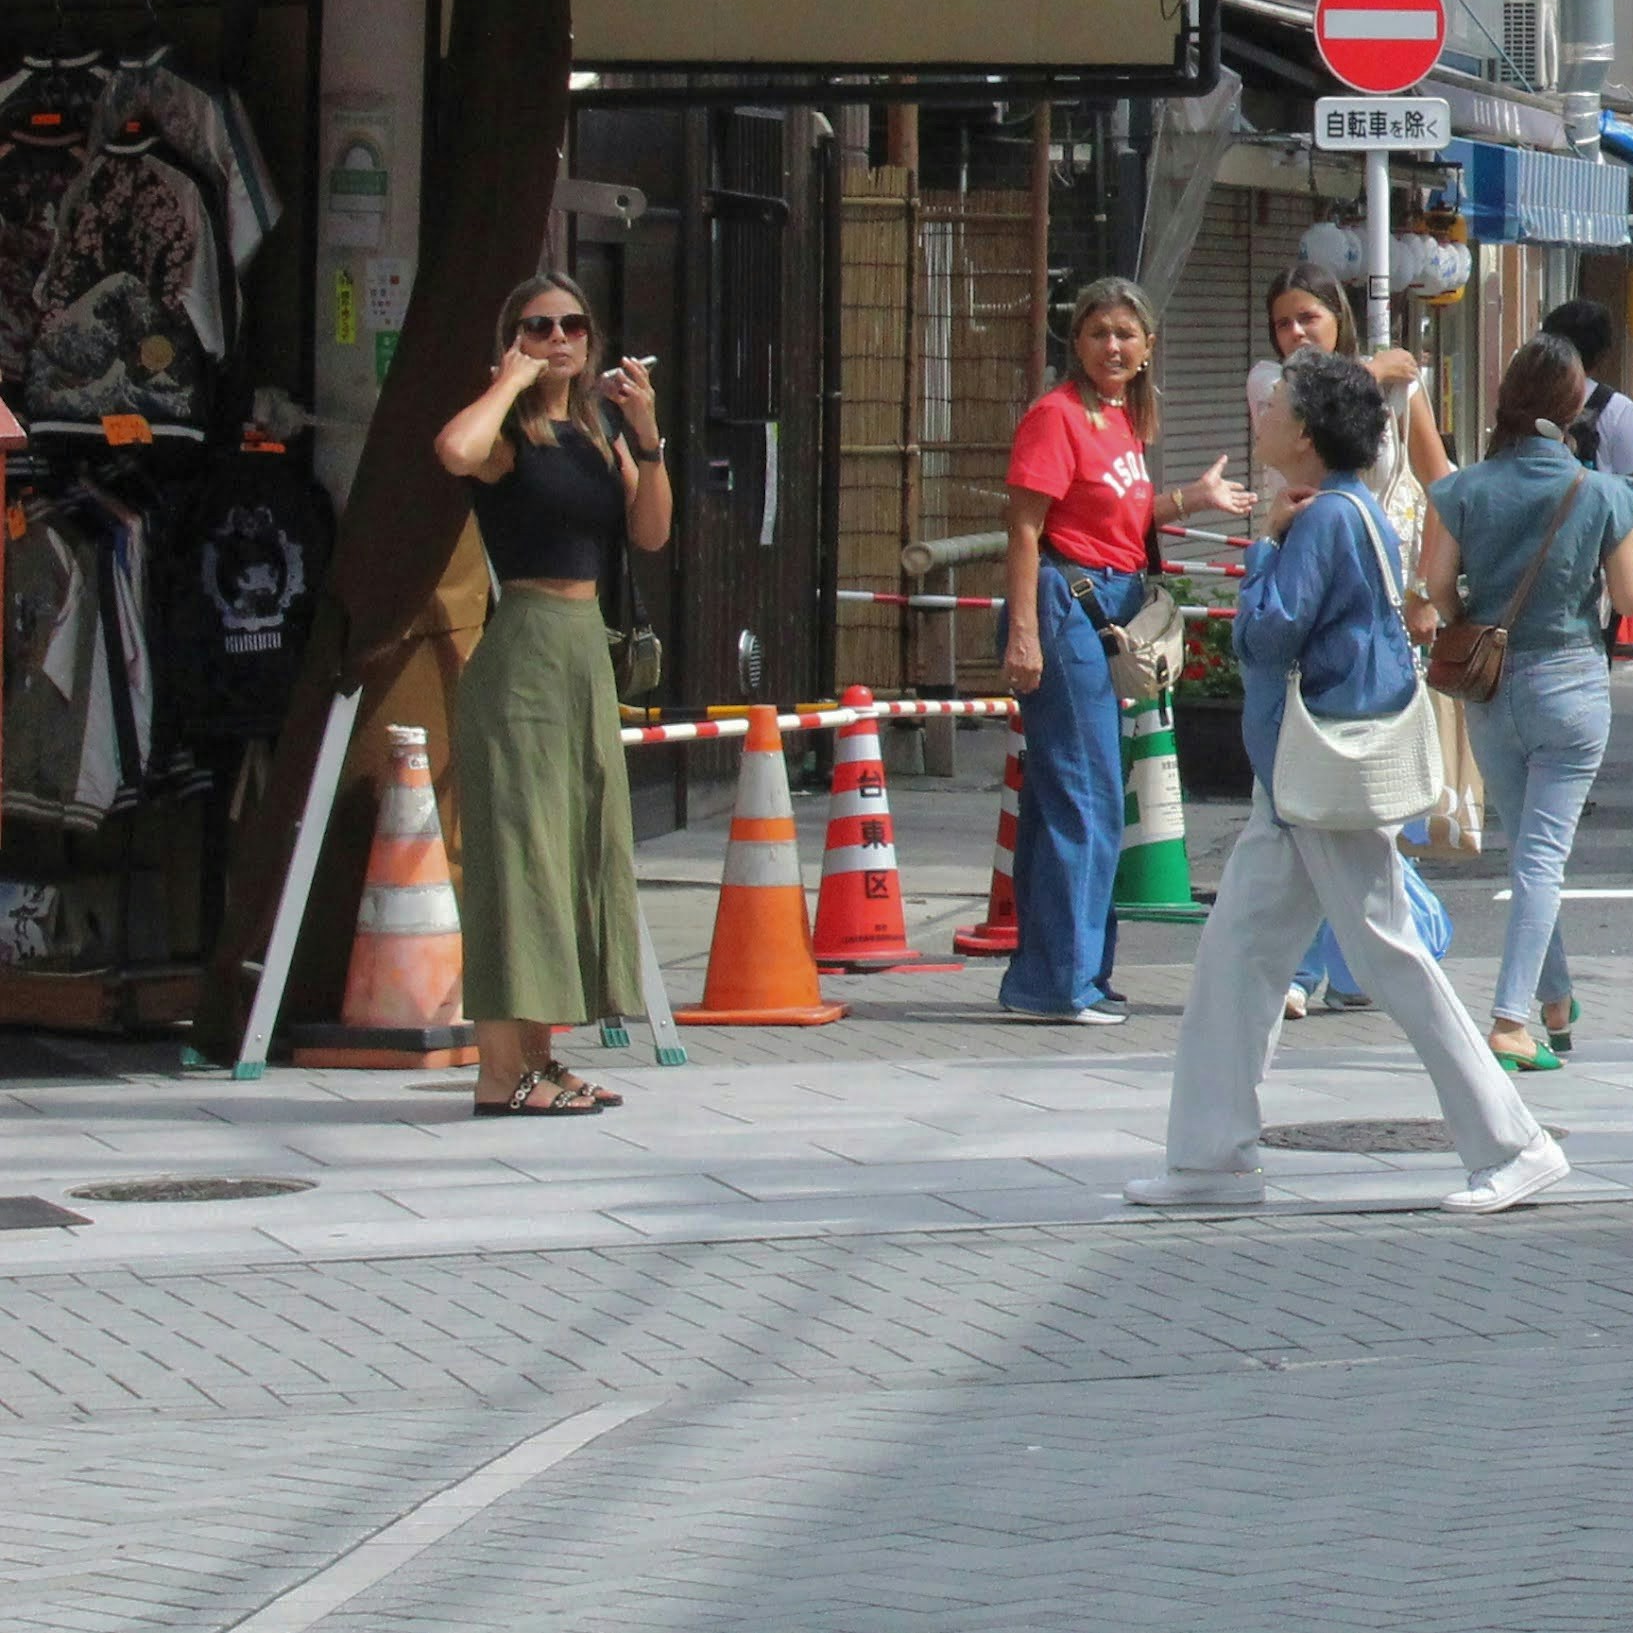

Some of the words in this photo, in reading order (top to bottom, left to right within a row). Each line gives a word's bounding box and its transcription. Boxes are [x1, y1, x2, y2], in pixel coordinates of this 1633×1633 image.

[1326, 110, 1438, 139] 自転車を除く
[856, 768, 889, 900] 台東区
